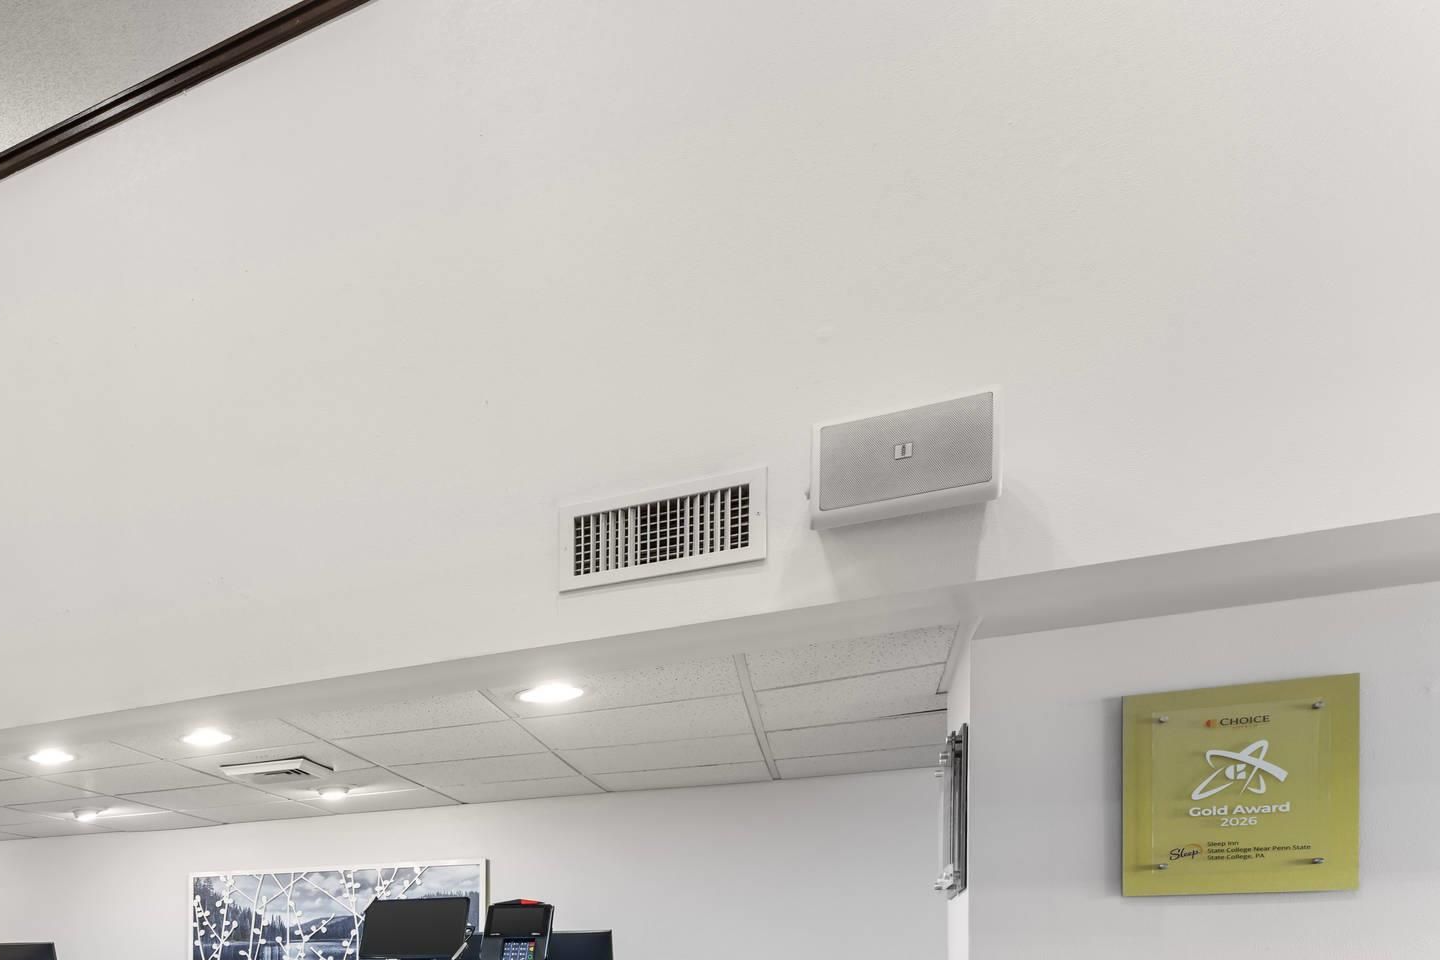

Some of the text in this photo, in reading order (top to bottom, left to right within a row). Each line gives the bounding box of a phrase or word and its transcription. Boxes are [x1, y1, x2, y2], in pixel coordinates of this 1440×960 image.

[1220, 715, 1271, 726] CHOICE
[1189, 801, 1291, 817] Gold Award
[1220, 817, 1258, 827] 2026
[1169, 847, 1200, 860] Sleep
